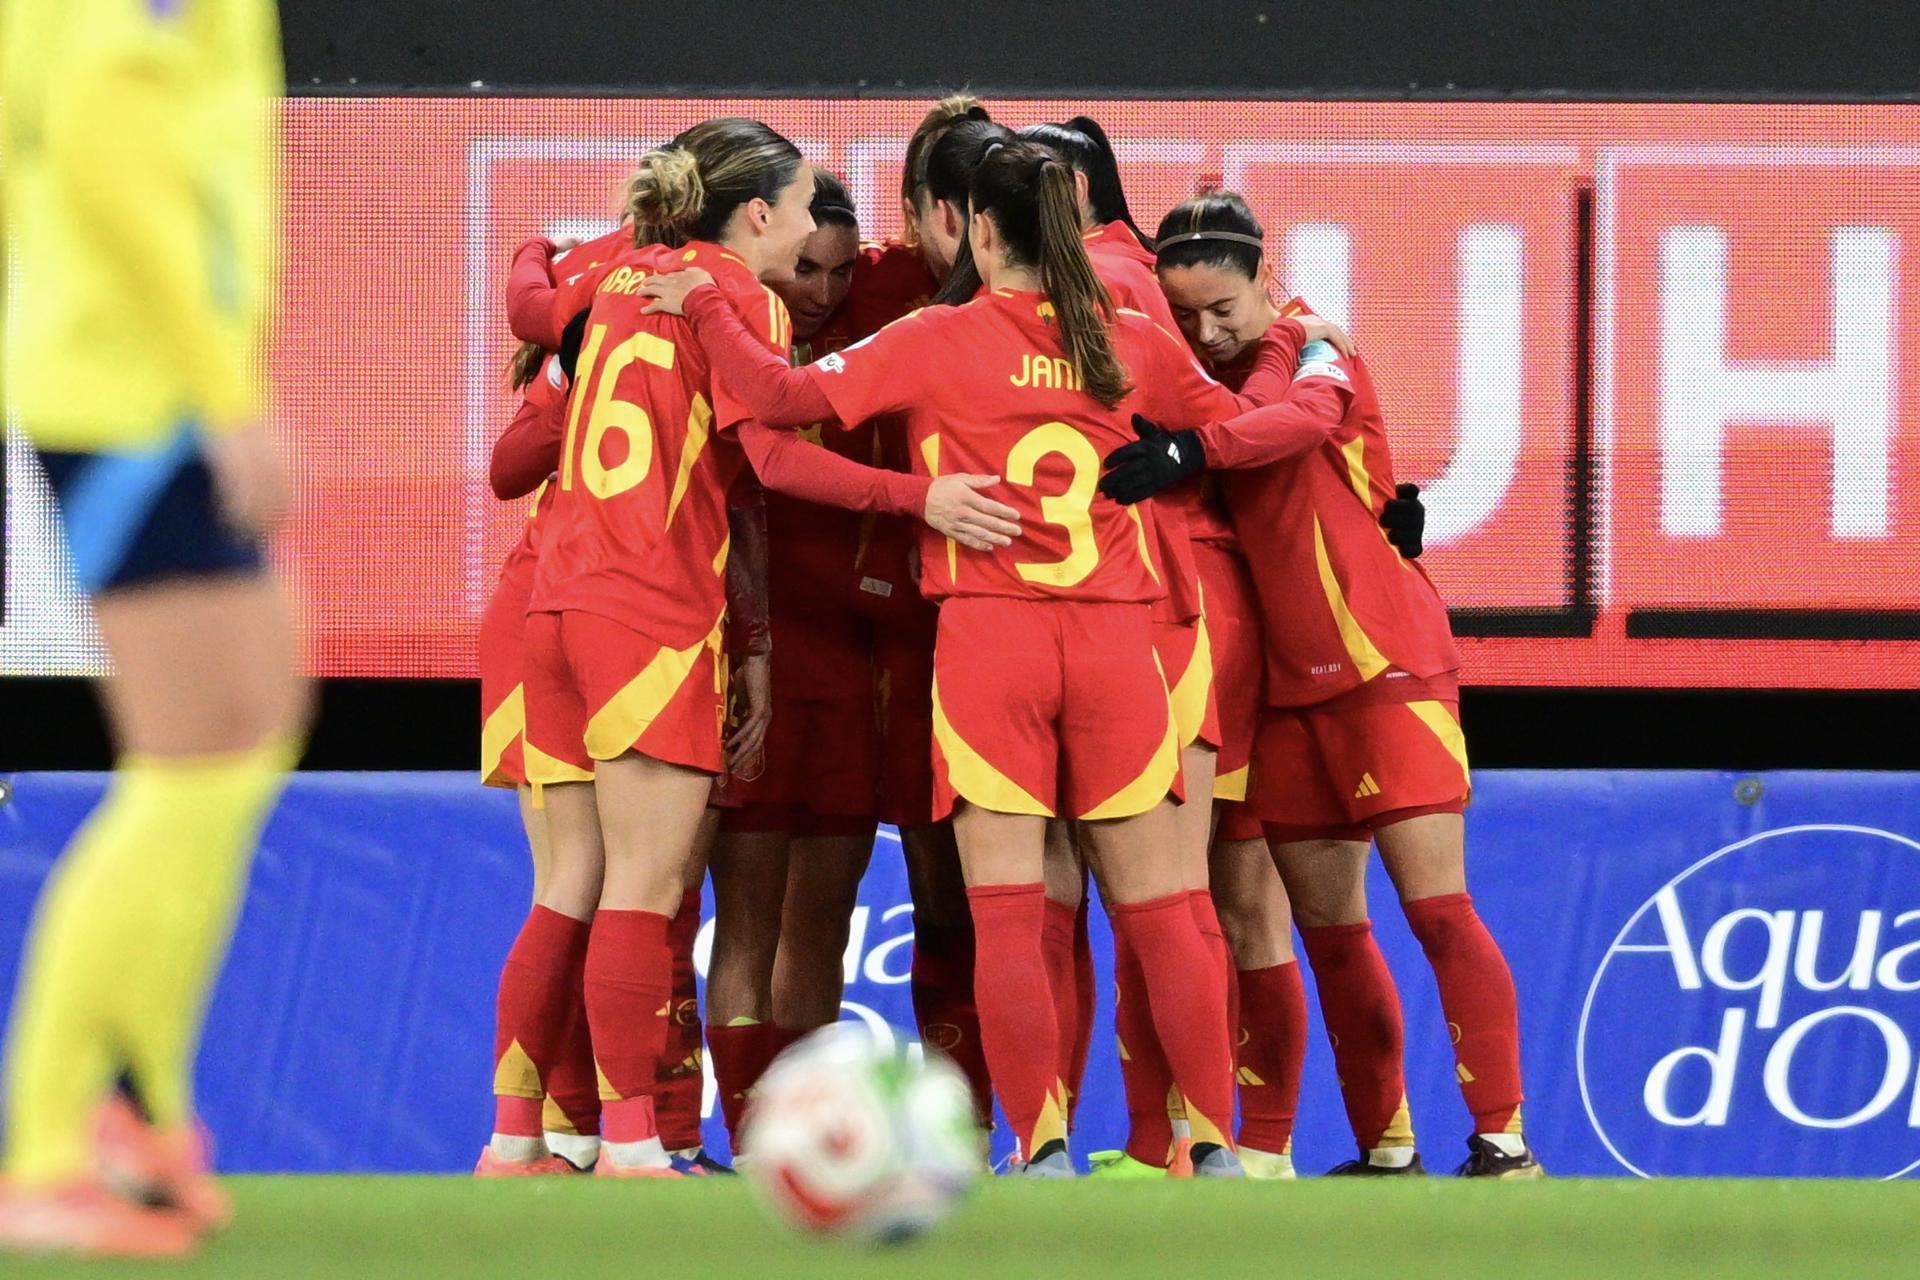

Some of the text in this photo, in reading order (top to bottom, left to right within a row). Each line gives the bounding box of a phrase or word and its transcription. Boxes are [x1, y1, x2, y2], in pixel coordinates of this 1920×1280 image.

[562, 324, 675, 499] 16
[1006, 421, 1100, 587] 3
[1610, 885, 1920, 1029] Aqua
